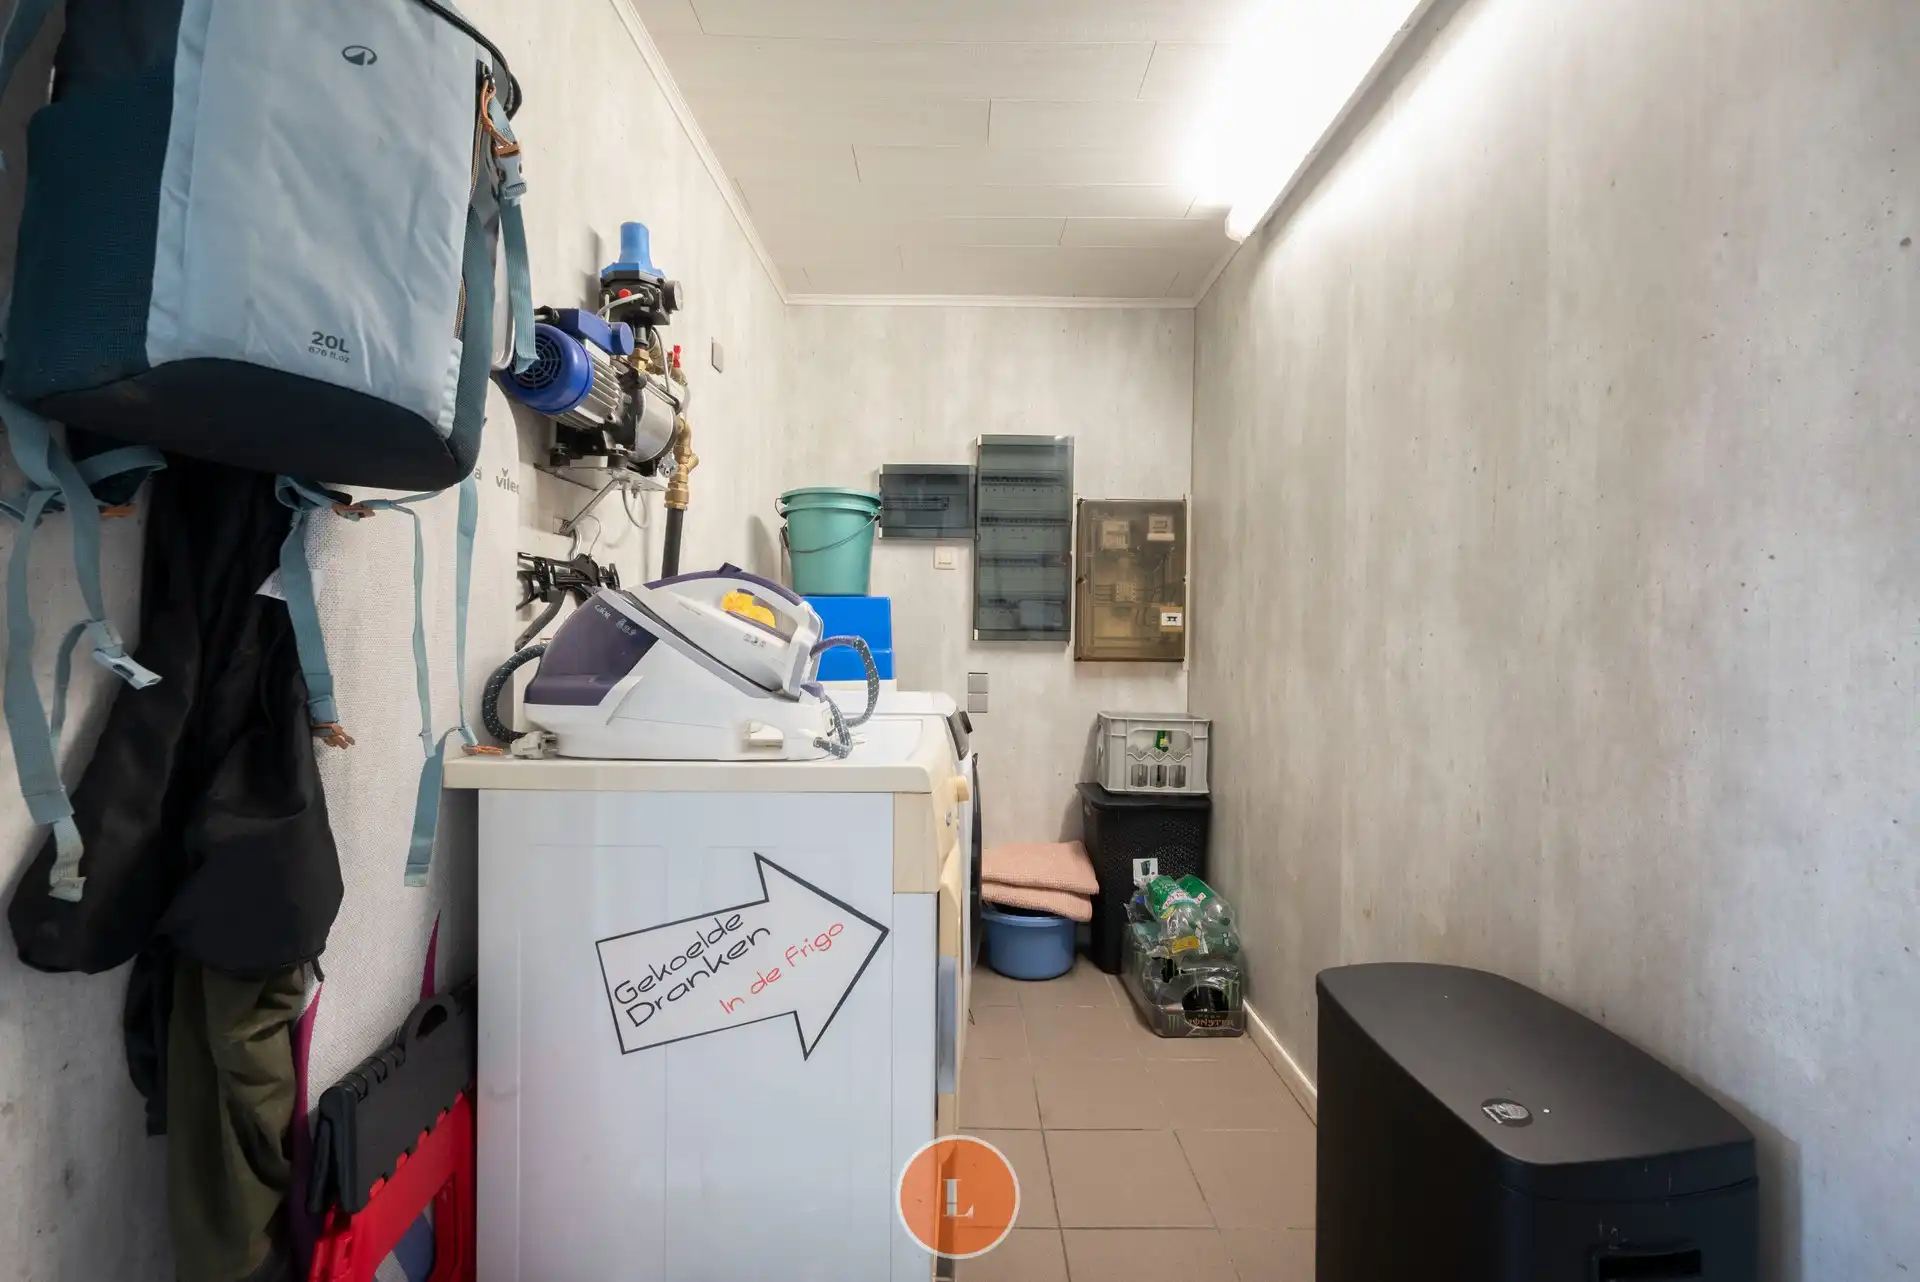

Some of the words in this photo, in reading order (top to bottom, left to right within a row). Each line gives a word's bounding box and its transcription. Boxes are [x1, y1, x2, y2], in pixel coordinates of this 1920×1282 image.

[311, 331, 350, 354] 20L
[614, 914, 743, 1005] Gekoelde
[626, 927, 771, 1027] Dranken
[719, 996, 745, 1014] In
[750, 967, 782, 995] de
[785, 923, 844, 967] Frigo
